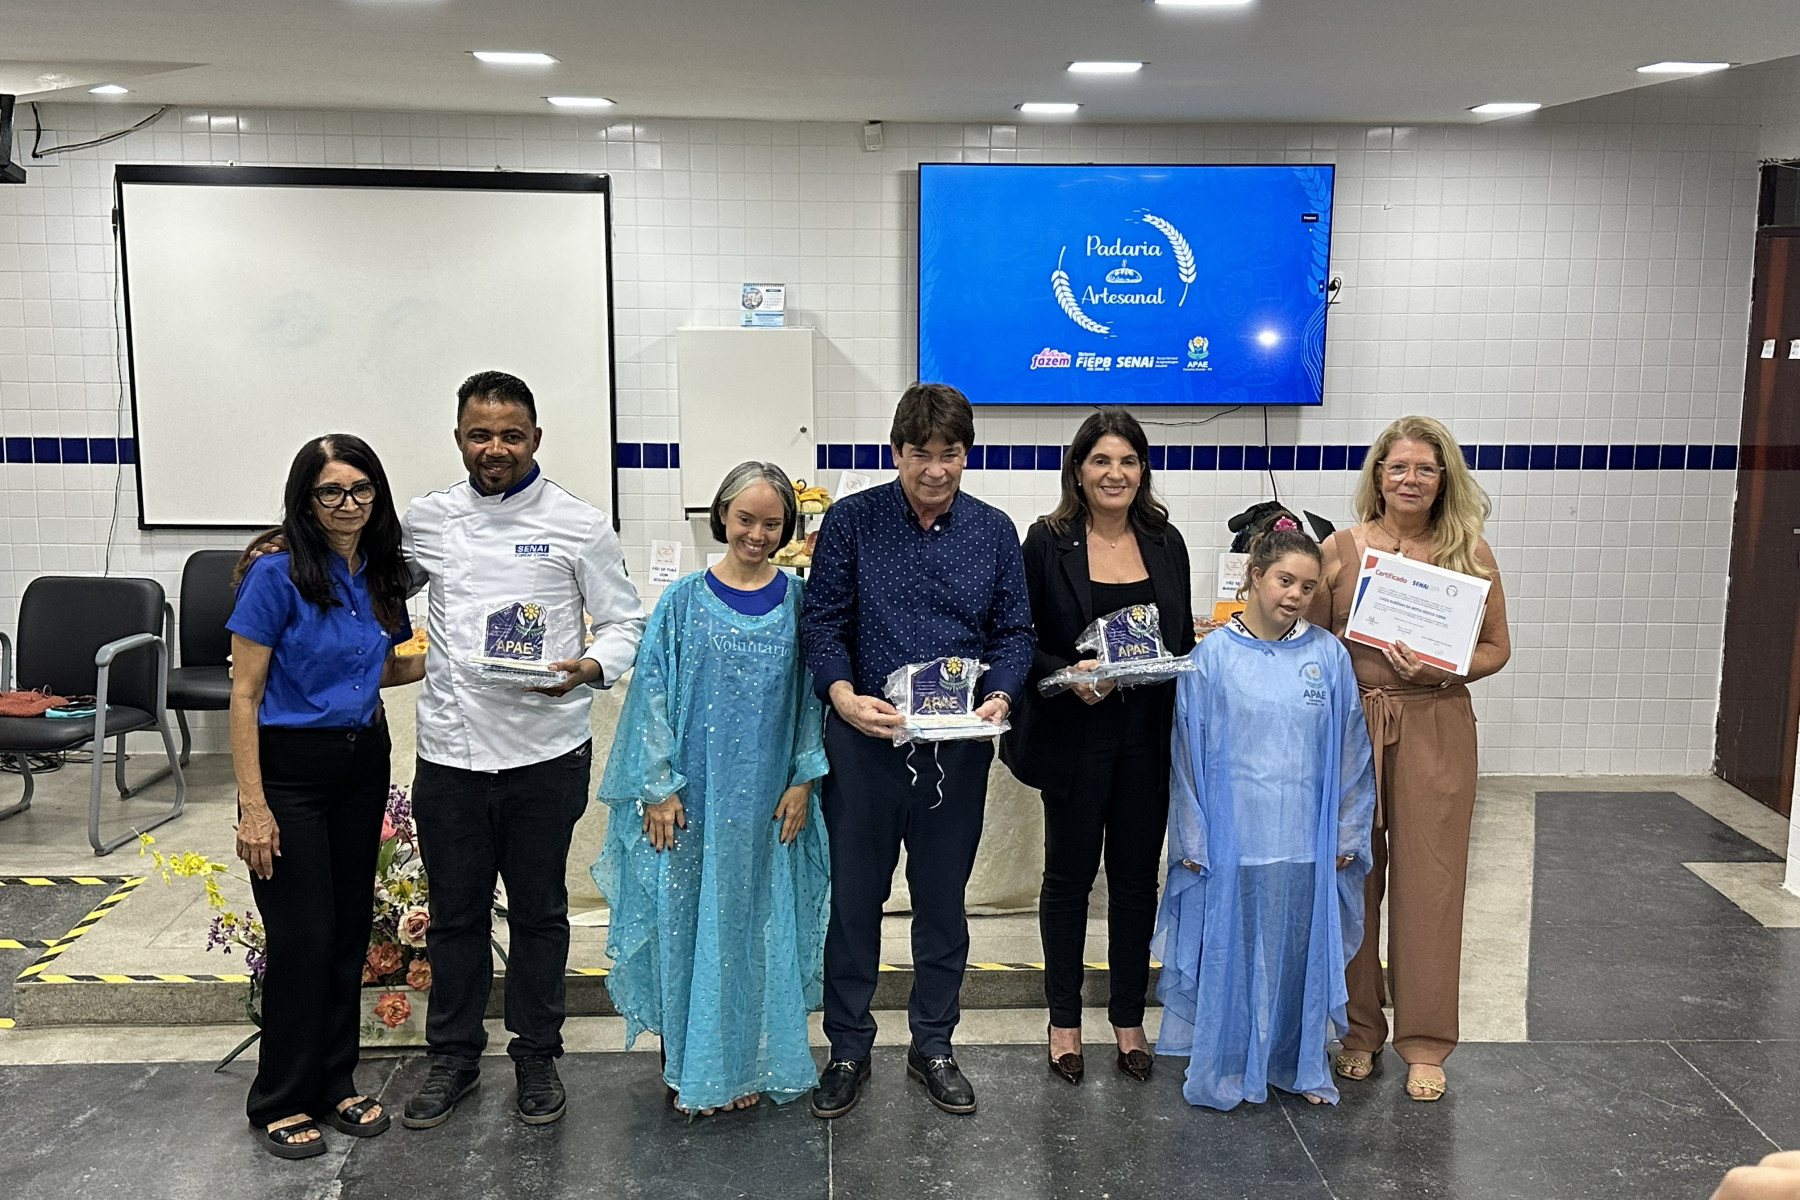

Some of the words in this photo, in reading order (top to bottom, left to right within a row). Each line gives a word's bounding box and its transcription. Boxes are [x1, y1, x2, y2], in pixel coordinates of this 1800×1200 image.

[1086, 235, 1163, 256] Padaria
[1081, 285, 1165, 305] Artesanal
[1032, 355, 1070, 368] fazem
[517, 545, 548, 553] SENAI
[1376, 569, 1408, 584] Certificado
[496, 640, 532, 656] APAE
[711, 635, 790, 657] Voluntário
[1118, 641, 1150, 658] APAE
[1303, 689, 1327, 700] APAE
[922, 696, 959, 710] APAE
